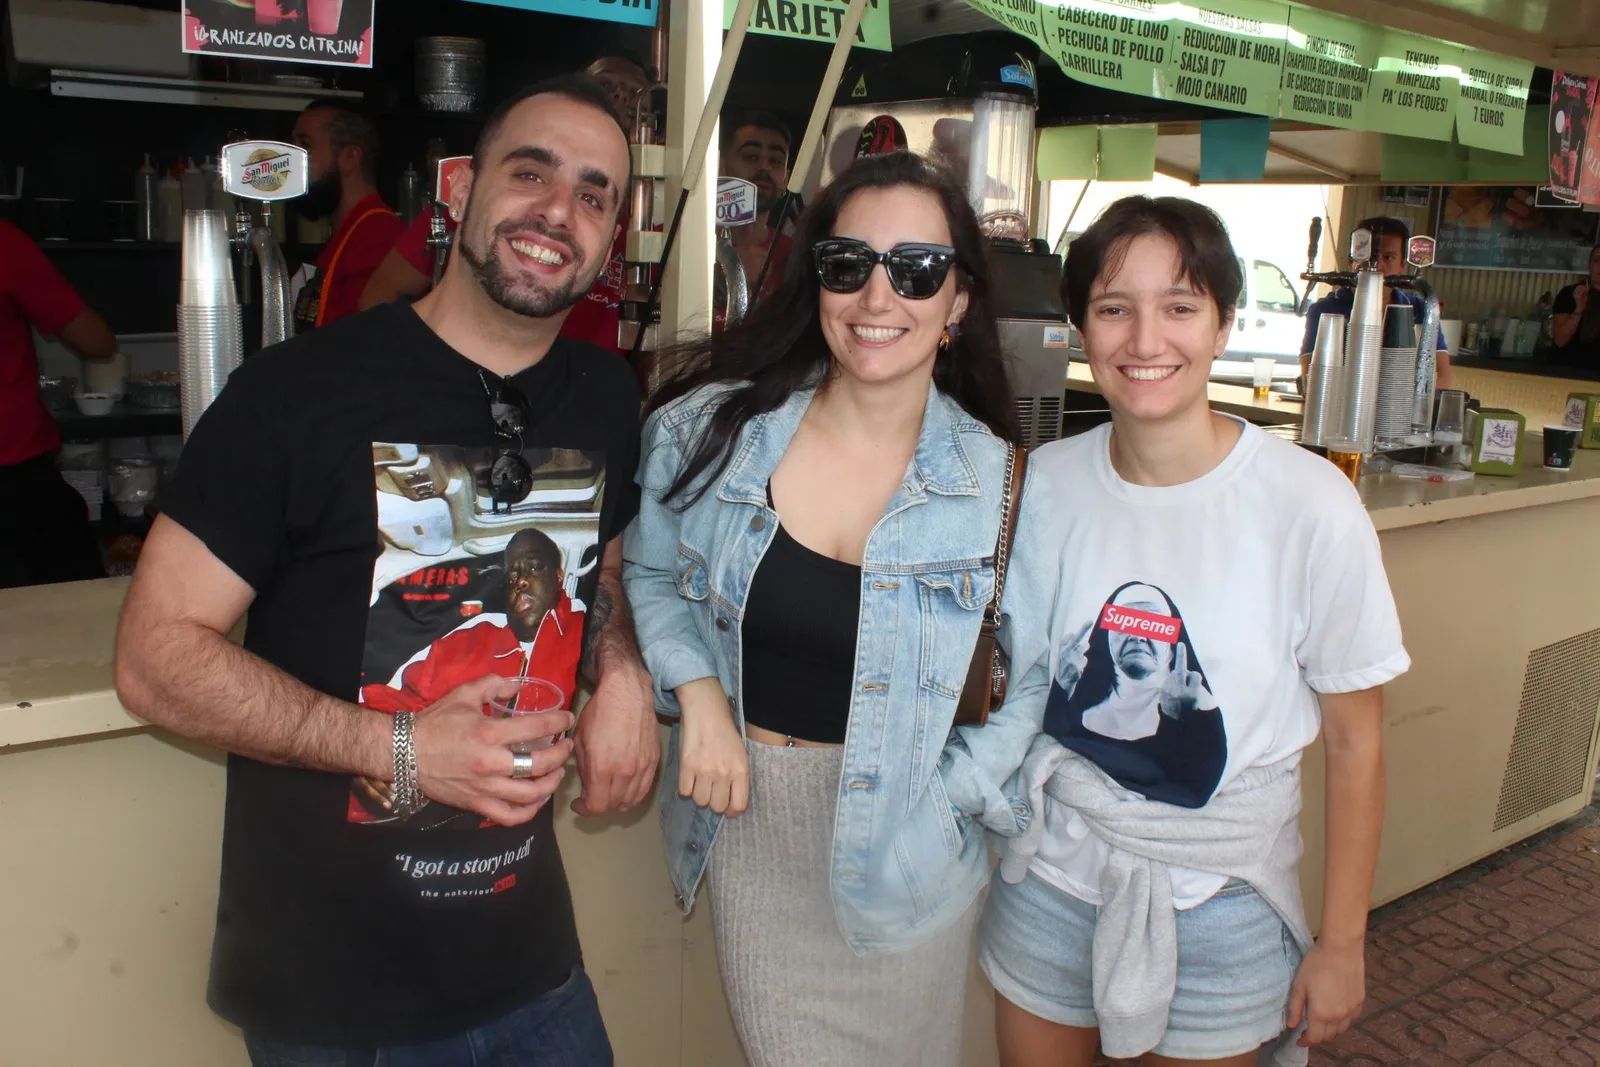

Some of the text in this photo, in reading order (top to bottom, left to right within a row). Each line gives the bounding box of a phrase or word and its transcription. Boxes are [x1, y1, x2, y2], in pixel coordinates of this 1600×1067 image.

[747, 0, 865, 43] ARJET
[1006, 13, 1038, 36] POLLO
[1058, 4, 1169, 41] CABECERO DE LOMO
[299, 36, 364, 56] CATRINA!
[1057, 27, 1164, 64] PECHUGA DE POLLO
[1239, 39, 1252, 60] DE
[1253, 43, 1280, 66] MORA
[1061, 50, 1123, 81] CARRILLERA
[1180, 51, 1209, 75] SALSA
[1286, 51, 1317, 73] CHAPATITA
[1405, 50, 1440, 70] TENEMOS
[1286, 72, 1363, 102] DE CABECERO DE LOMO CON
[1395, 69, 1441, 91] MINIPIZZAS
[1469, 67, 1495, 86] BOTELLA
[1495, 73, 1504, 88] DE
[1176, 75, 1247, 105] MOJO CANARIO
[1397, 91, 1414, 107] LOS
[1414, 94, 1449, 112] PEQUES!
[1460, 84, 1525, 110] NATURAL O FRIZZANTE
[1327, 100, 1336, 117] DE
[1336, 102, 1352, 119] MORA
[1473, 106, 1505, 127] 7 EUROS
[1103, 607, 1177, 637] Supreme
[411, 859, 445, 879] got
[447, 861, 461, 875] a
[462, 855, 503, 875] story
[503, 850, 515, 867] to
[420, 887, 494, 898] the notorious
